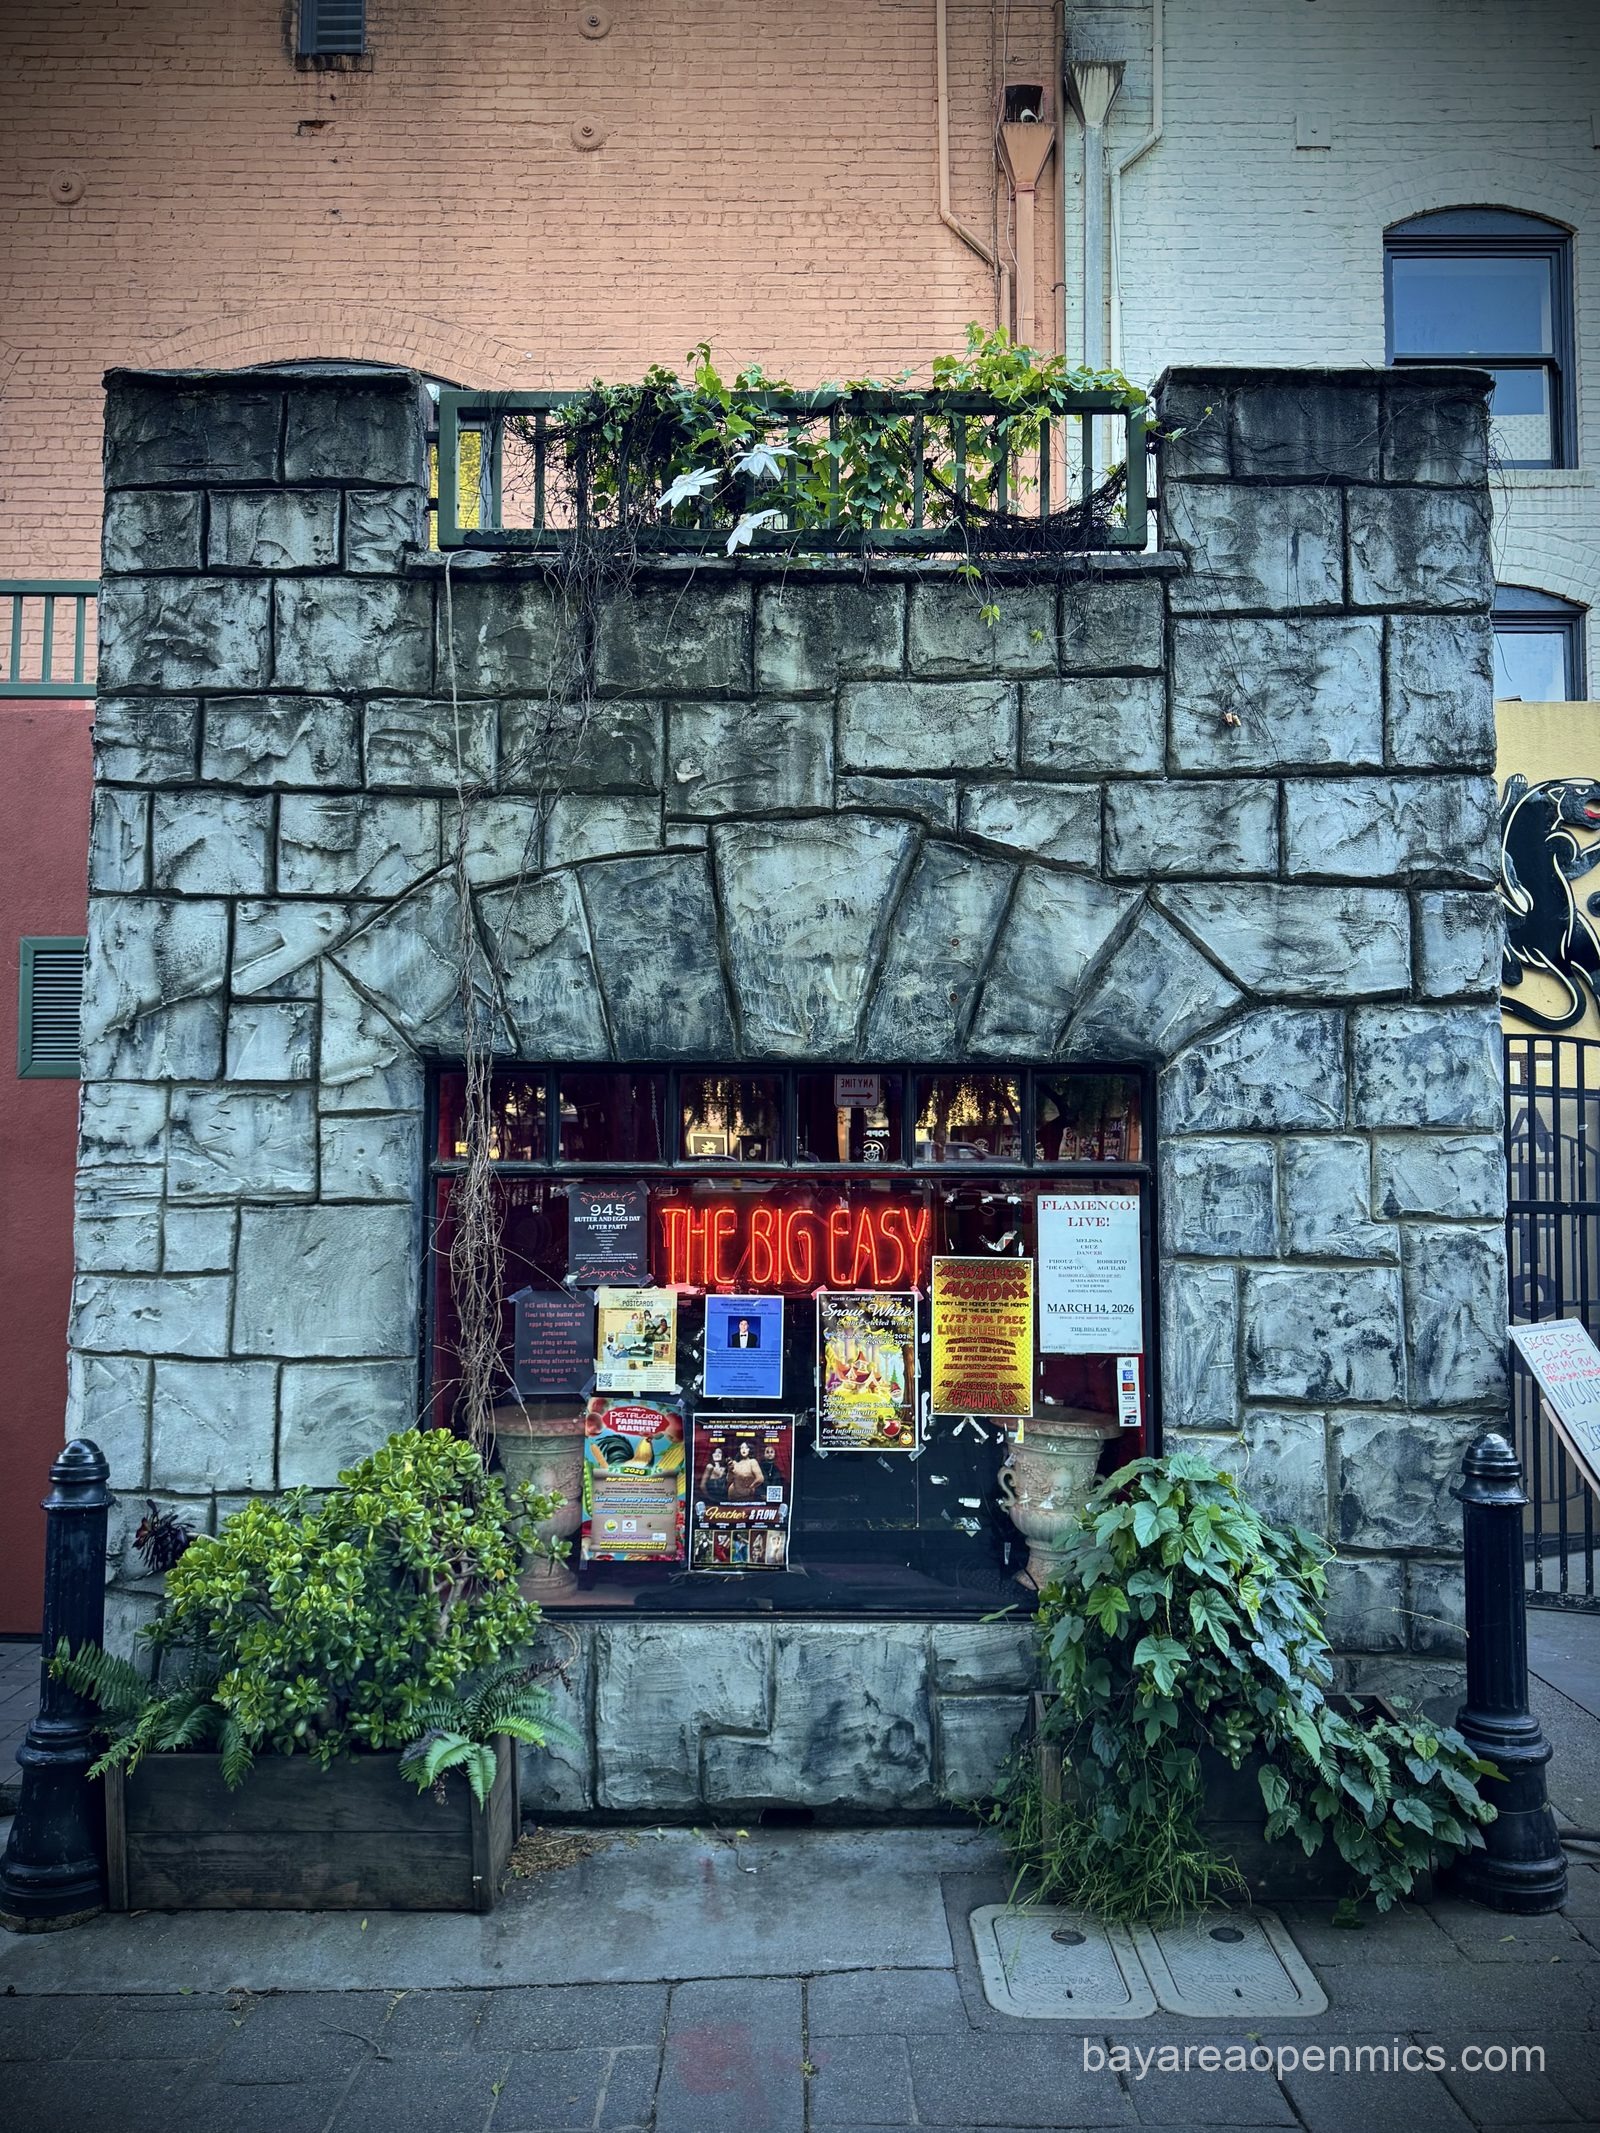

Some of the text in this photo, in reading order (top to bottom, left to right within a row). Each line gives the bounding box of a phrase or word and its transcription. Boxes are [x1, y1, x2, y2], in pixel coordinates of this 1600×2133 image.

[590, 1204, 626, 1216] 945
[1041, 1200, 1136, 1211] FLAMENCO!
[1068, 1217, 1110, 1227] LIVE!
[662, 1207, 928, 1285] THE BIG EASY
[940, 1281, 1029, 1301] MONDAY
[822, 1303, 913, 1320] Snow White
[1047, 1304, 1135, 1314] MARCH 14, 2026
[997, 1315, 1027, 1324] FREE
[937, 1325, 1027, 1337] LIVE MUSIC BY
[617, 1425, 657, 1433] MARKET
[705, 1506, 777, 1520] Feather & FLOW
